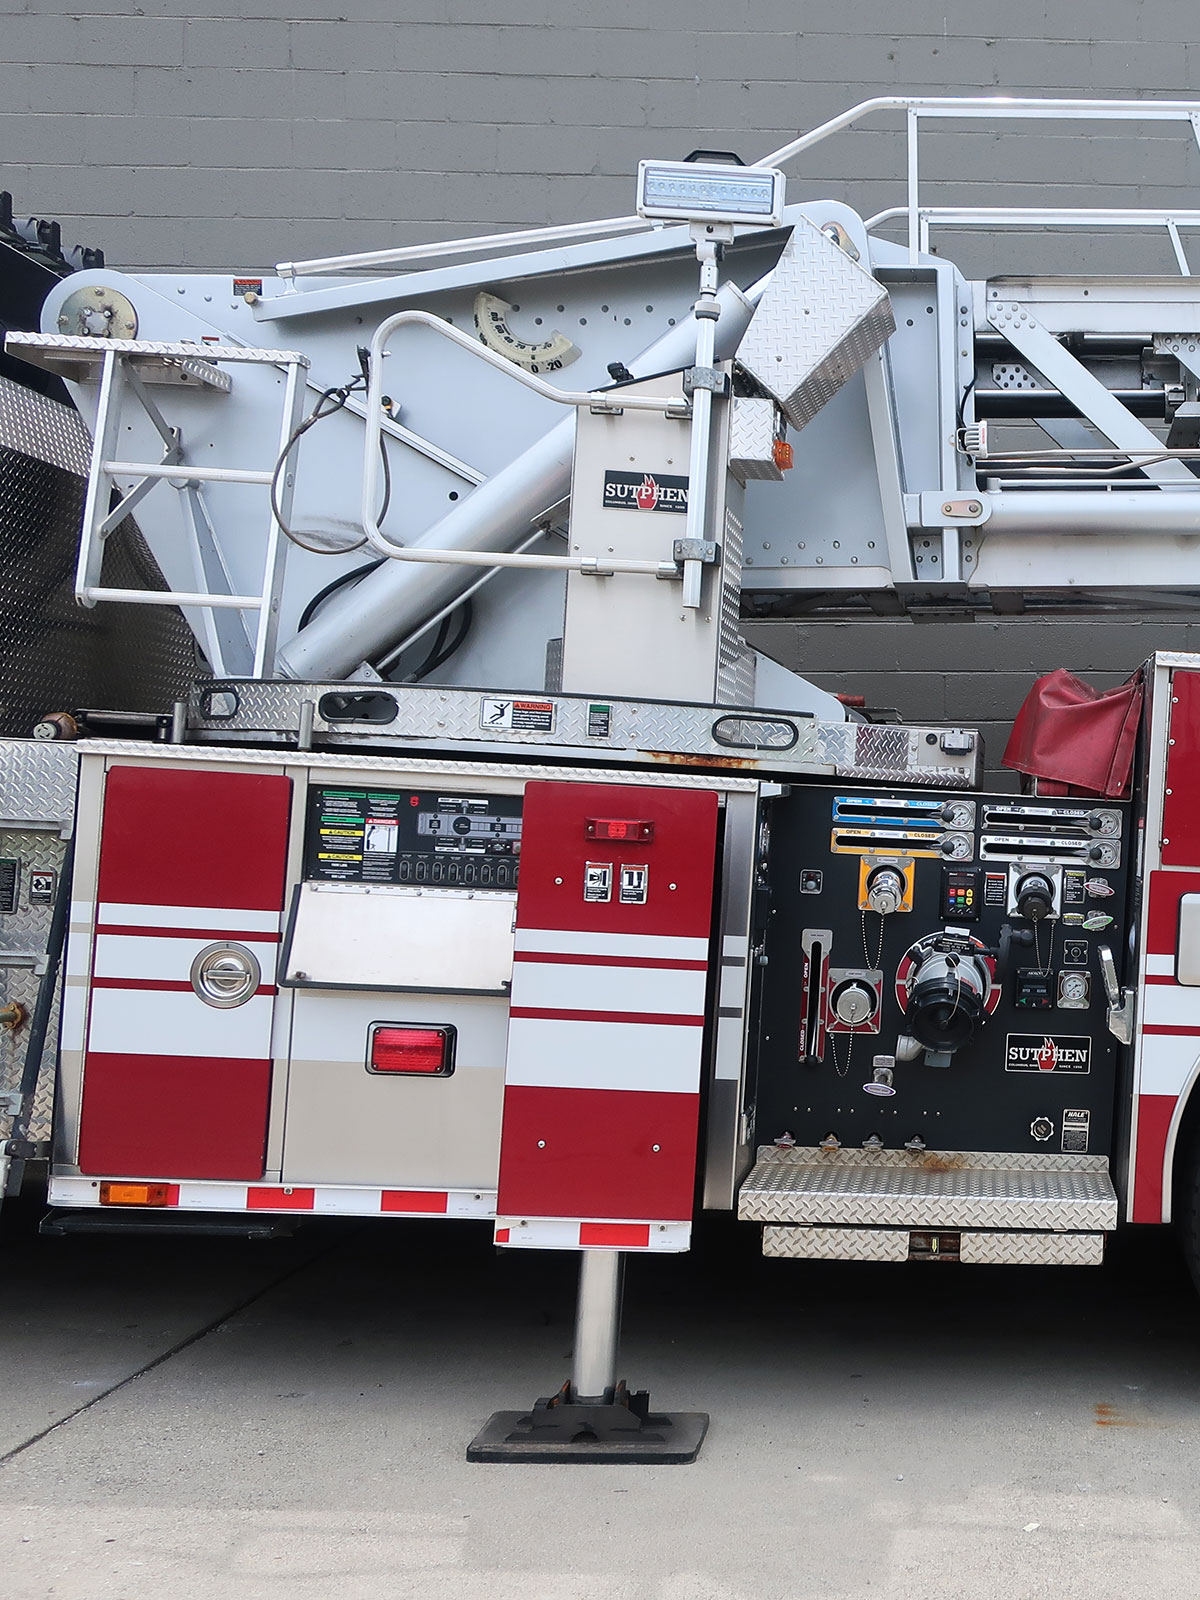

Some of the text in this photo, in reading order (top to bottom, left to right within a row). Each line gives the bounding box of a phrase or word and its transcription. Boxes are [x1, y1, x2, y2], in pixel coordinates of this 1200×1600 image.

[530, 364, 539, 373] 0
[605, 483, 689, 503] SUTPHEN
[519, 703, 552, 711] WARNING
[1008, 1047, 1088, 1062] SUTPHEN
